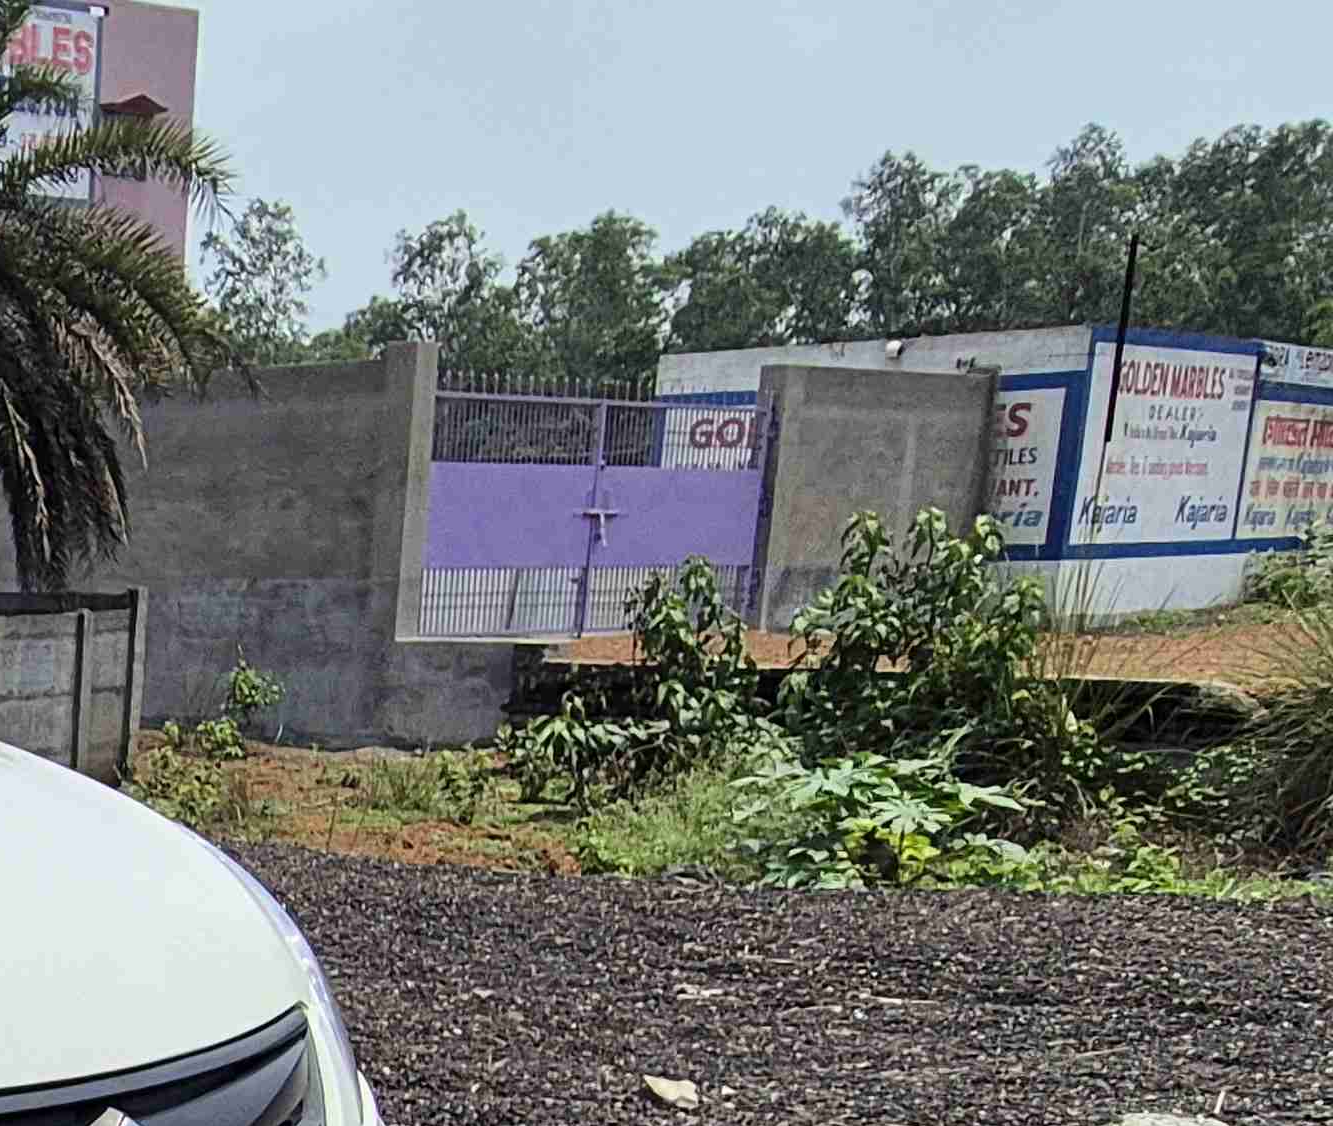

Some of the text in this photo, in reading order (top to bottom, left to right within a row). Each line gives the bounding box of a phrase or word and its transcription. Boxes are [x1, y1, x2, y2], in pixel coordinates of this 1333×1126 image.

[1119, 360, 1169, 398] GOLDEN
[1170, 364, 1226, 400] MARBLES
[1174, 496, 1228, 529] Kajaria
